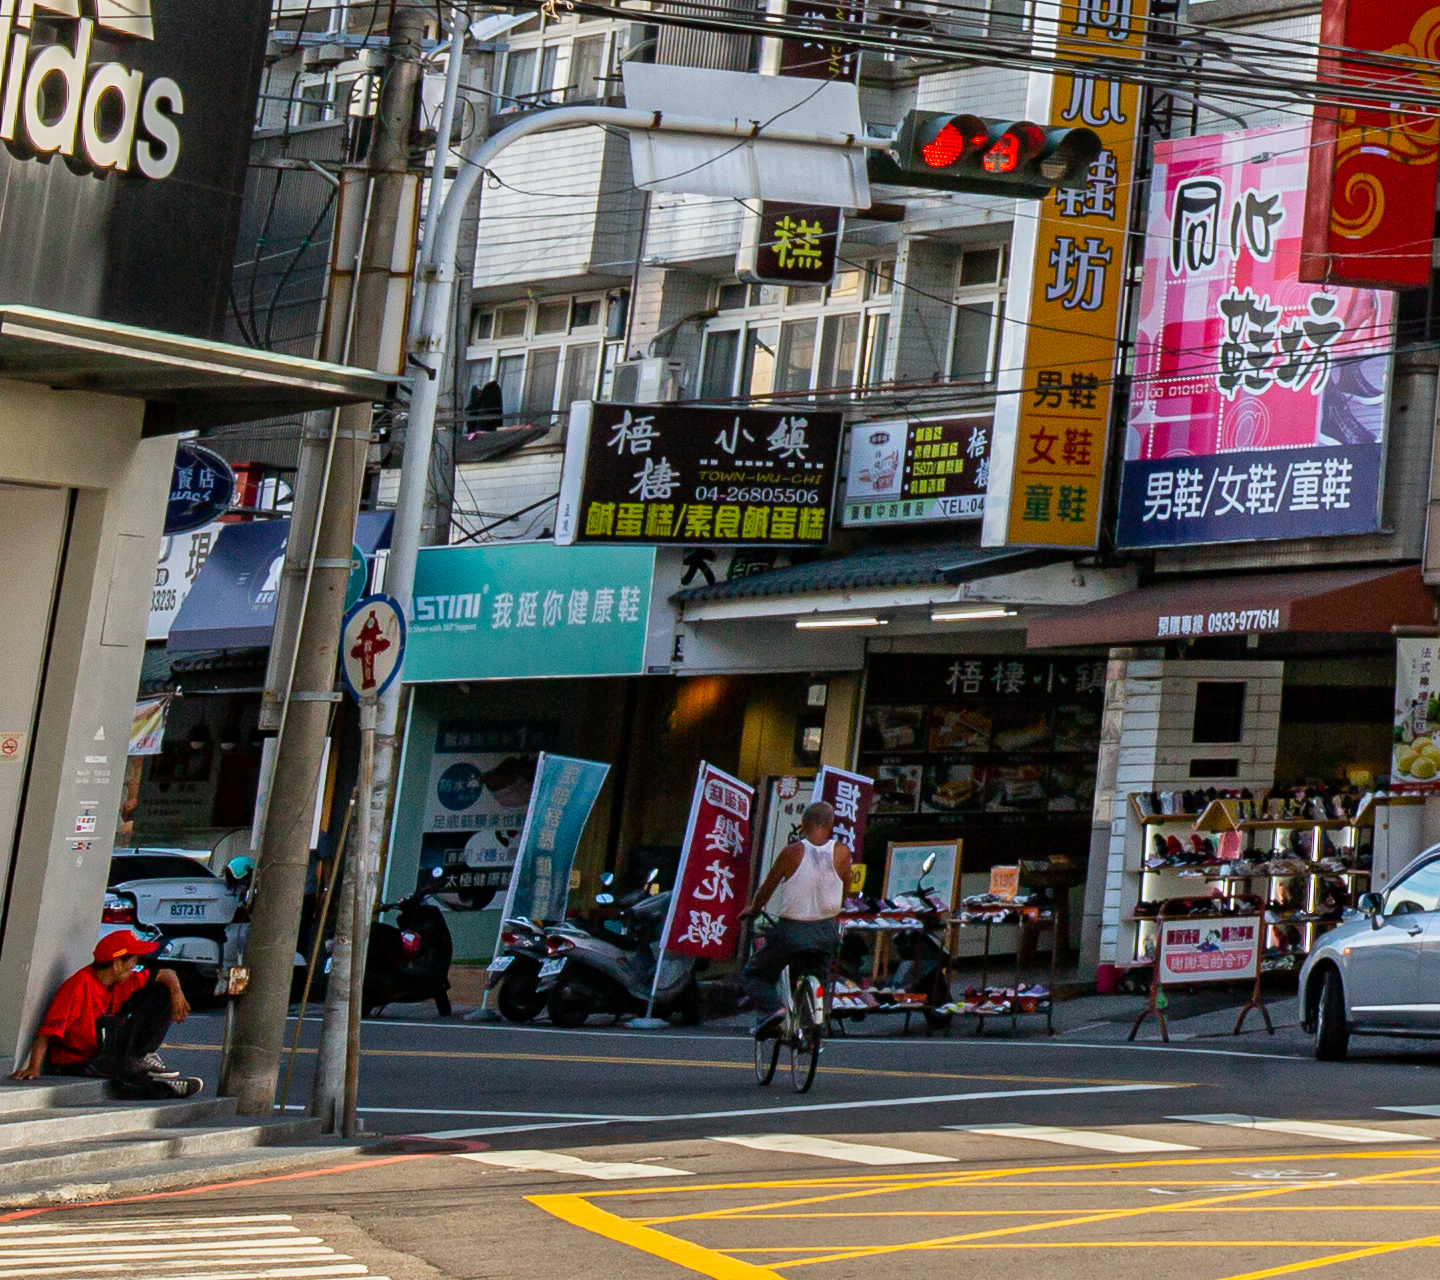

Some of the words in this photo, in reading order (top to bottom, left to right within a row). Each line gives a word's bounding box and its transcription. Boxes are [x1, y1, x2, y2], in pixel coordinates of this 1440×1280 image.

[1174, 176, 1285, 278] 同心
[1219, 286, 1346, 398] 鞋坊
[1032, 370, 1097, 409] 男鞋
[1026, 426, 1092, 467] 女鞋
[695, 486, 819, 505] 04-26805506
[1022, 483, 1088, 523] 童鞋
[1142, 457, 1353, 523] 男鞋/女鞋/童鞋
[492, 586, 642, 630] 我挺你健康鞋
